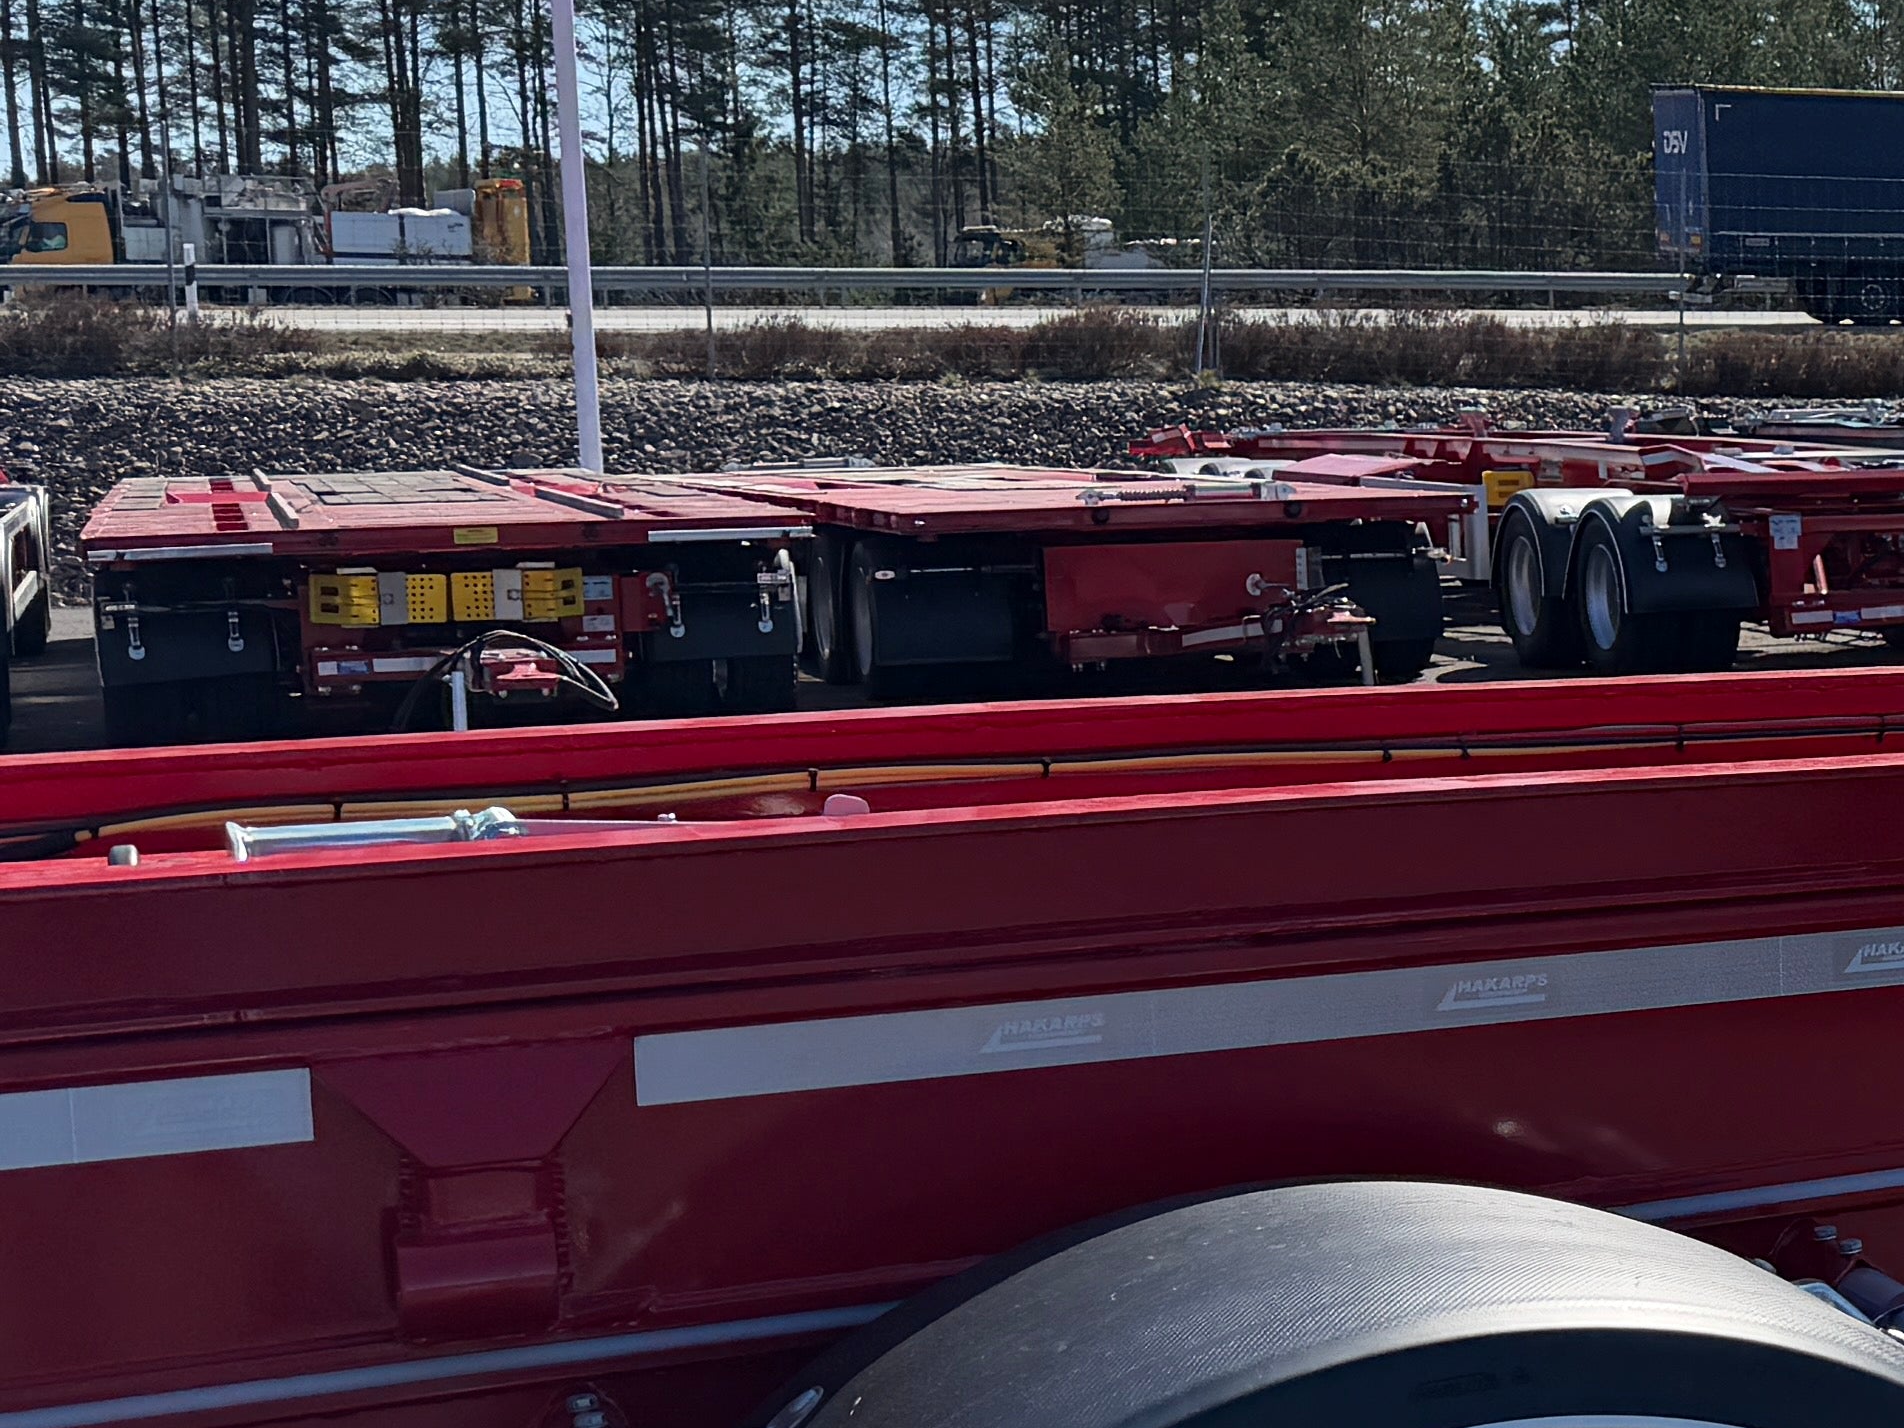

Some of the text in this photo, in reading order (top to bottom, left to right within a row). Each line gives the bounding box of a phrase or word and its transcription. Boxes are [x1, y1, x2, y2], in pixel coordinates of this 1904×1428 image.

[1663, 130, 1688, 154] DSV
[1457, 973, 1549, 995] HAKARPS
[1003, 1012, 1106, 1035] HAKARPS
